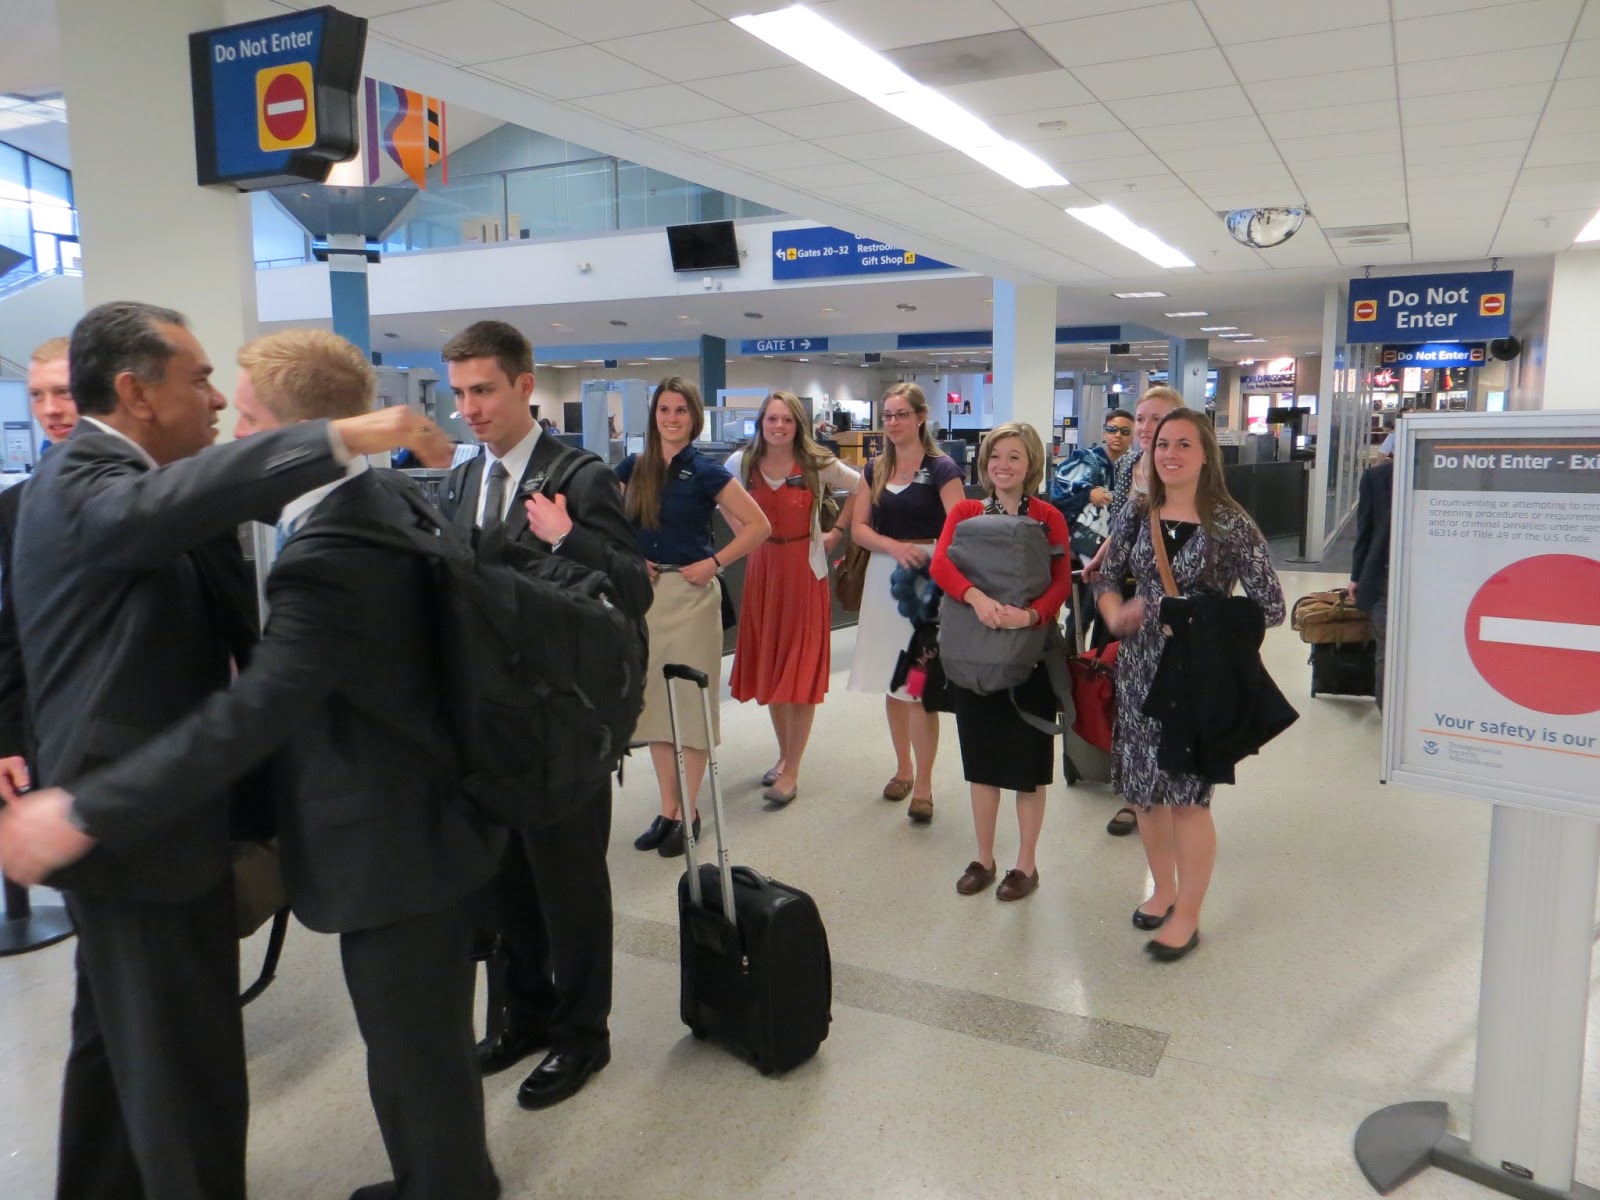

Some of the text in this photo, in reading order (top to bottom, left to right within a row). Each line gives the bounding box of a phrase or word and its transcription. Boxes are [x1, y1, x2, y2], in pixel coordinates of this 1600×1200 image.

[214, 30, 314, 63] Do Not Enter
[797, 249, 821, 258] Gates
[857, 244, 903, 253] Restroom
[862, 255, 903, 266] Gift Shop
[1388, 287, 1470, 307] Do Not
[1396, 311, 1458, 329] Enter
[757, 339, 795, 351] GATE 1
[1397, 350, 1470, 361] Do Not Enter
[1433, 454, 1458, 469] Do
[1463, 454, 1496, 469] Not
[1500, 454, 1553, 470] Enter
[1429, 498, 1497, 509] Circumventing
[1512, 501, 1567, 511] attempting
[1569, 502, 1580, 510] to
[1428, 509, 1473, 519] screening
[1475, 510, 1529, 520] procedures
[1531, 512, 1542, 520] or
[1428, 519, 1460, 528] and/or
[1461, 520, 1501, 529] criminal
[1503, 521, 1547, 531] penalties
[1549, 523, 1579, 532] under
[1428, 528, 1458, 537] 46314
[1460, 530, 1472, 538] of
[1473, 530, 1494, 539] Title
[1496, 531, 1509, 539] 49
[1511, 531, 1522, 540] of
[1525, 532, 1541, 541] the
[1434, 712, 1597, 748] Your safety is our
